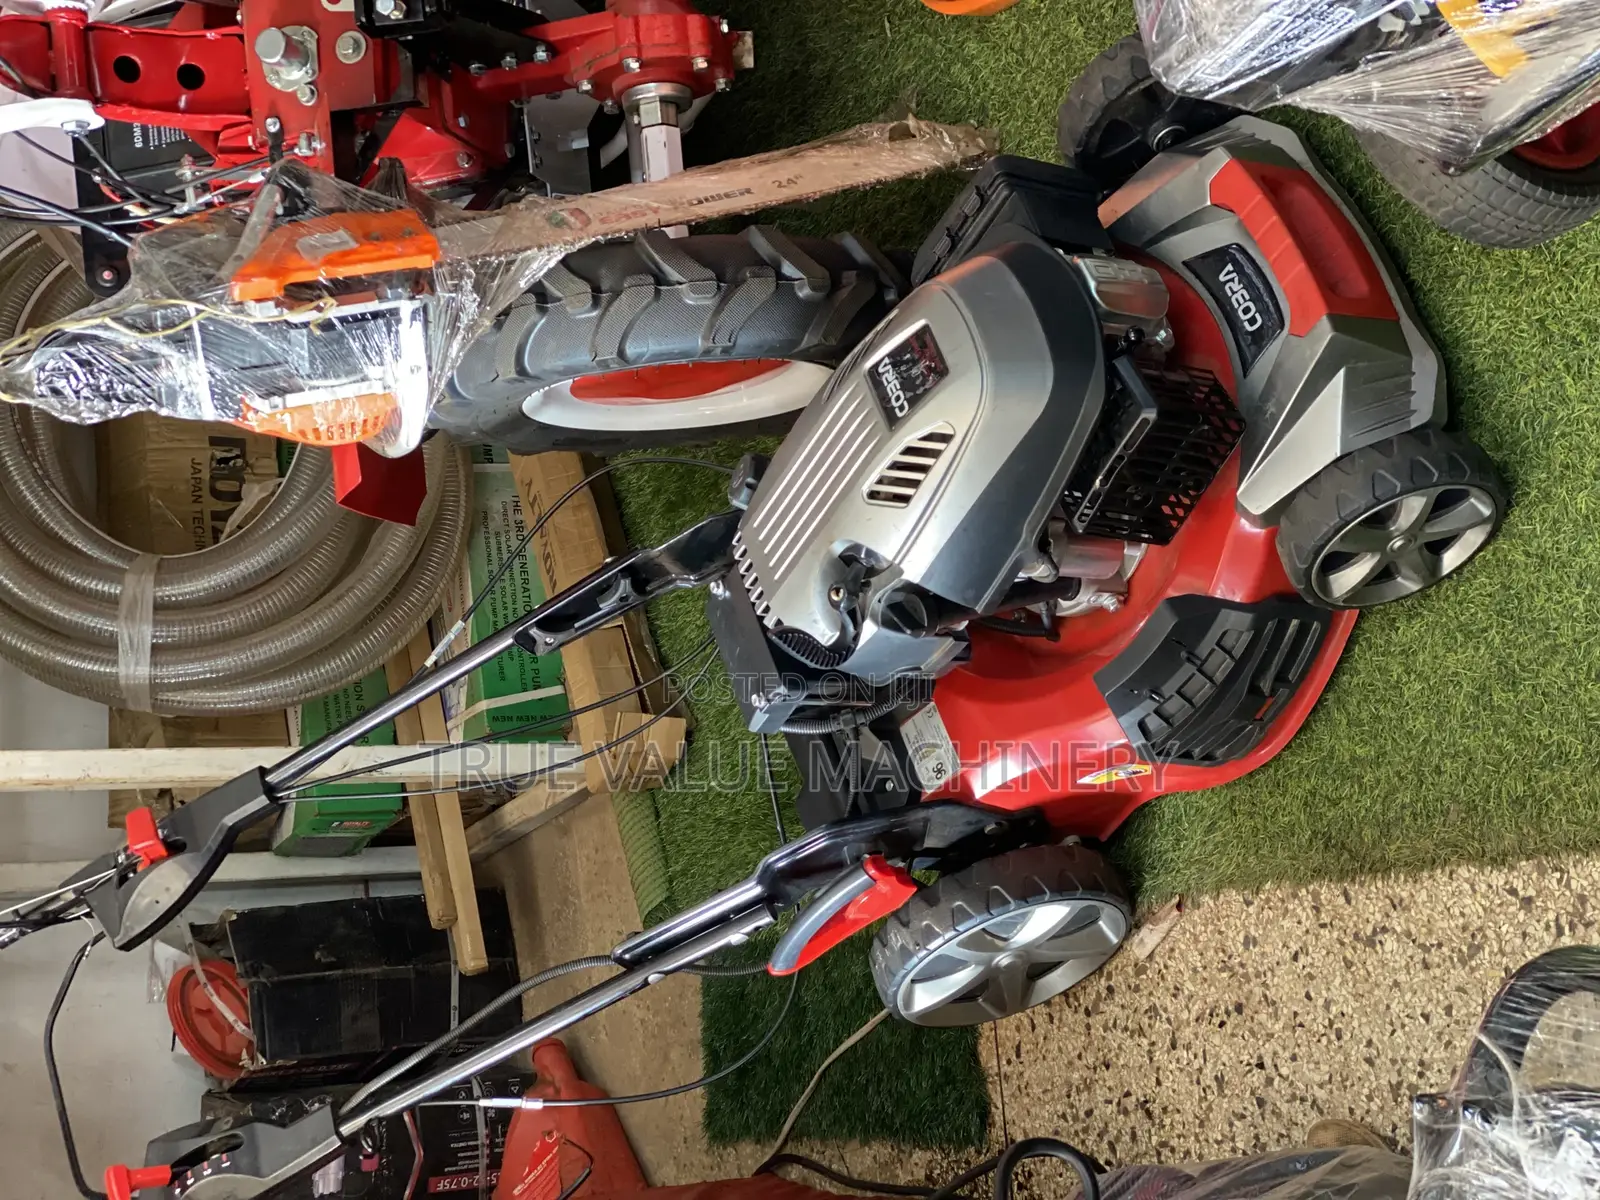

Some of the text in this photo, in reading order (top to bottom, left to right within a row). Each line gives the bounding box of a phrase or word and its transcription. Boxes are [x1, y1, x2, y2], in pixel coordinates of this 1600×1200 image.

[1217, 262, 1263, 331] COBRA
[877, 356, 909, 418] COBRA
[190, 457, 205, 504] JAPAN
[500, 500, 509, 528] DIRECT
[503, 529, 512, 554] SOLAR
[514, 519, 525, 541] 3RD
[482, 510, 494, 567] PROFESSIONAL
[490, 597, 498, 618] PUMP
[517, 549, 533, 614] GENERATIO
[512, 607, 519, 619] NO
[517, 647, 530, 692] ONTROLLER
[492, 715, 513, 723] NEW
[516, 715, 537, 723] NEW
[932, 762, 947, 780] 96
